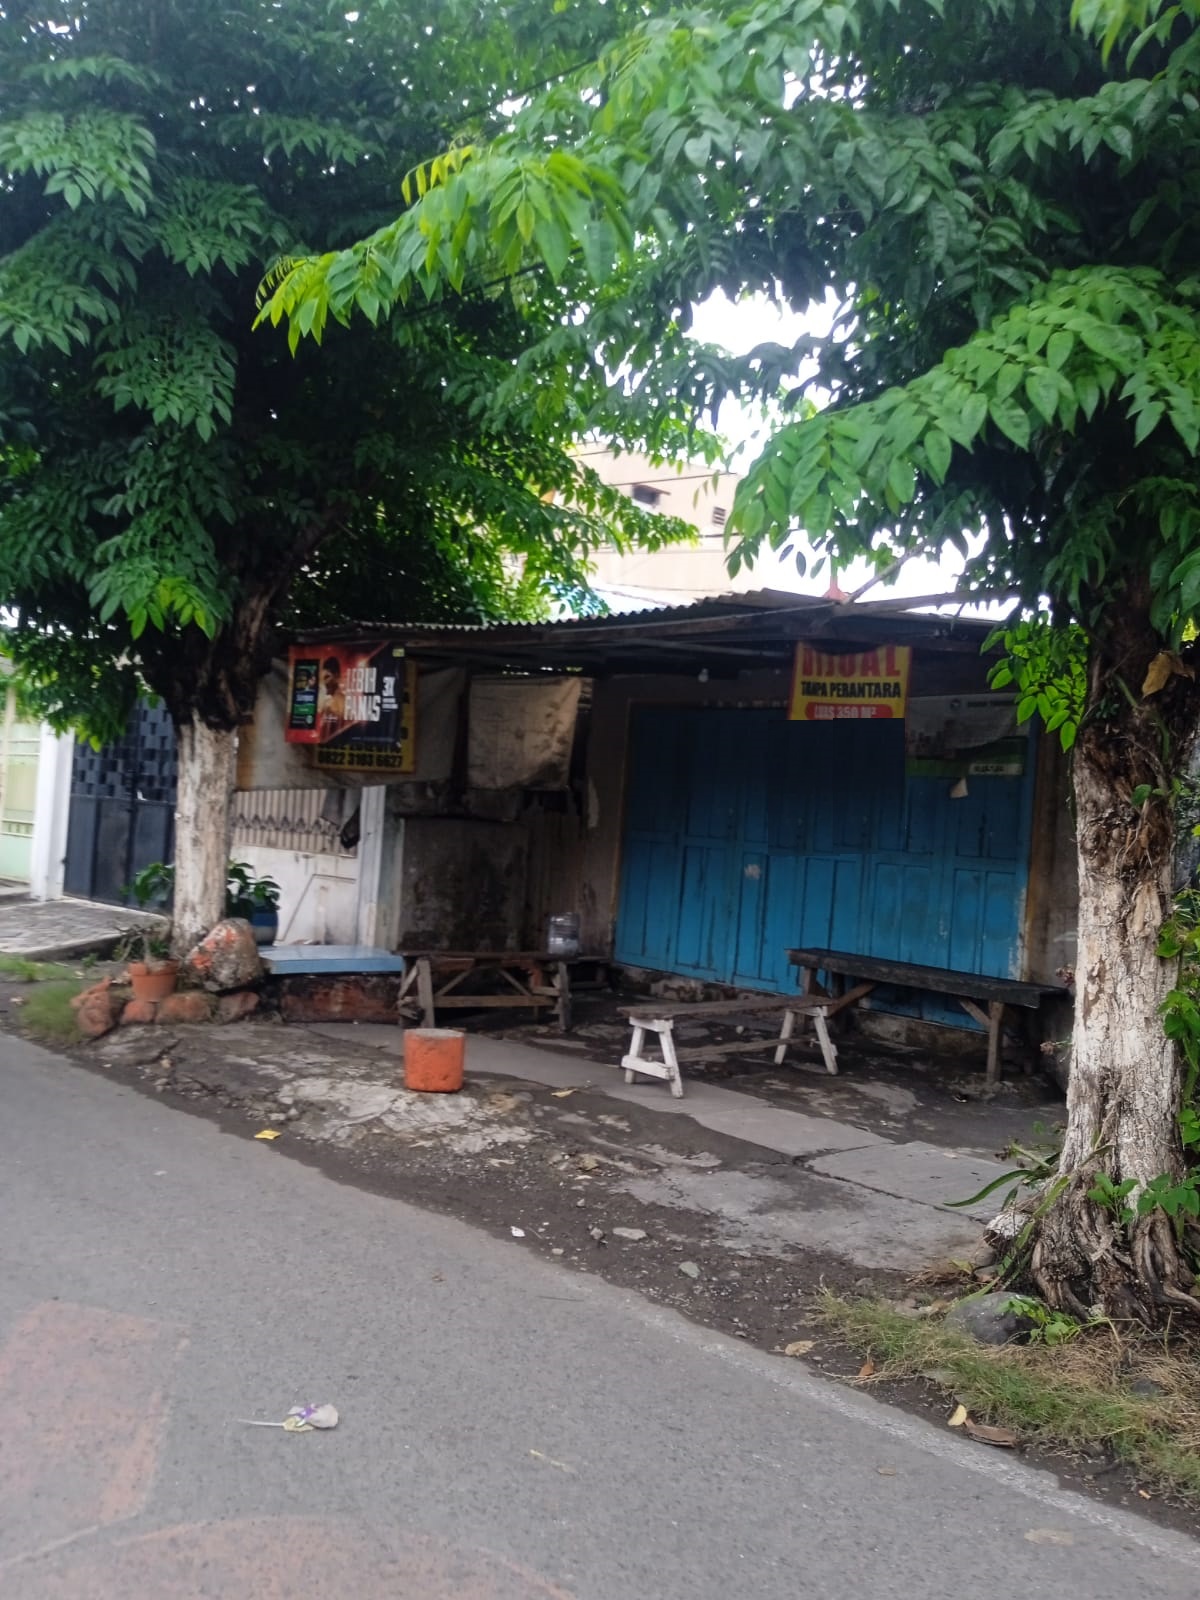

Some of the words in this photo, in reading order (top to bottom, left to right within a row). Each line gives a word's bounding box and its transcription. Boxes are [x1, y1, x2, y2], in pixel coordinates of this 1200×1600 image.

[802, 647, 901, 677] DIJUAL
[345, 667, 377, 693] LEBIH
[830, 682, 902, 698] PERANTARA
[343, 694, 381, 722] PANAS
